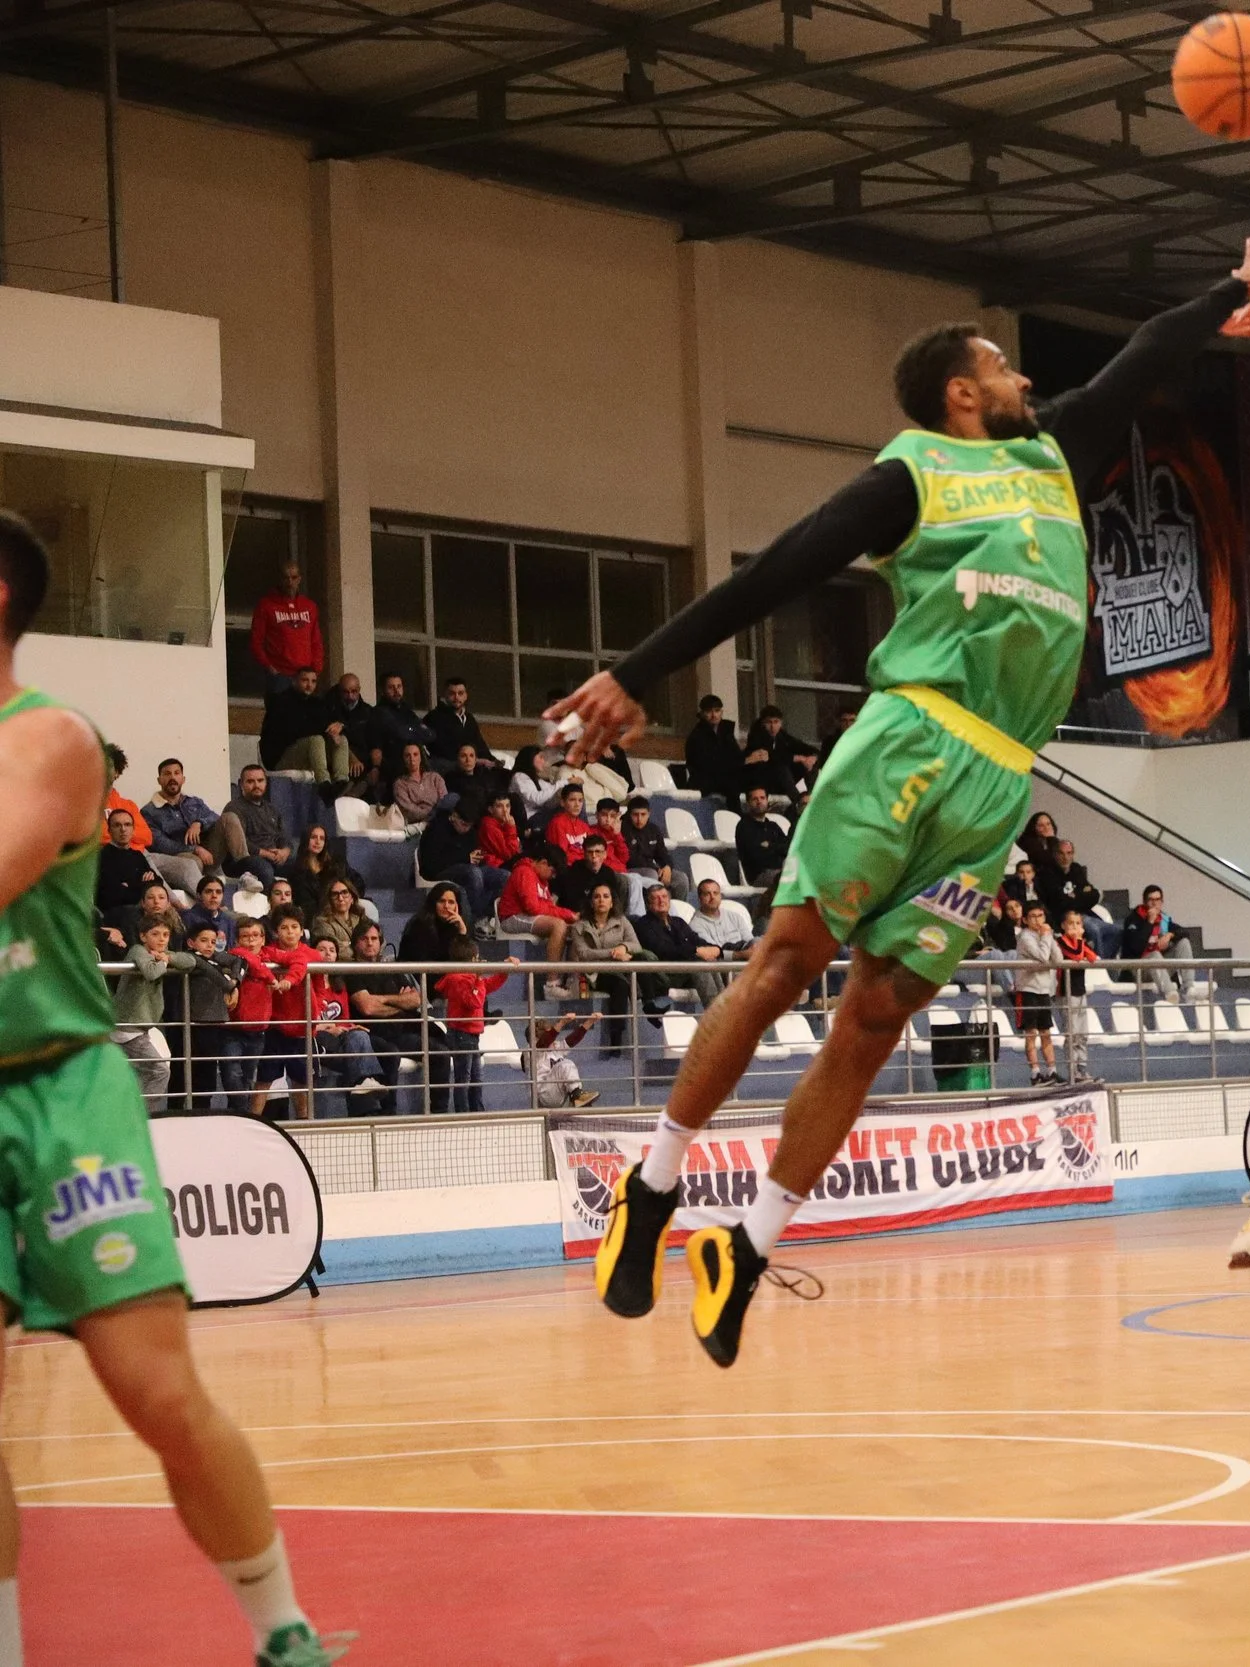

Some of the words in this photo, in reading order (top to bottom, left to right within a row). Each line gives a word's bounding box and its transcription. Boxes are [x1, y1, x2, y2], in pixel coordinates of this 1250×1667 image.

[1109, 597, 1205, 662] MAIA
[926, 1113, 1047, 1189] CLUBE
[48, 1165, 145, 1224] JMF
